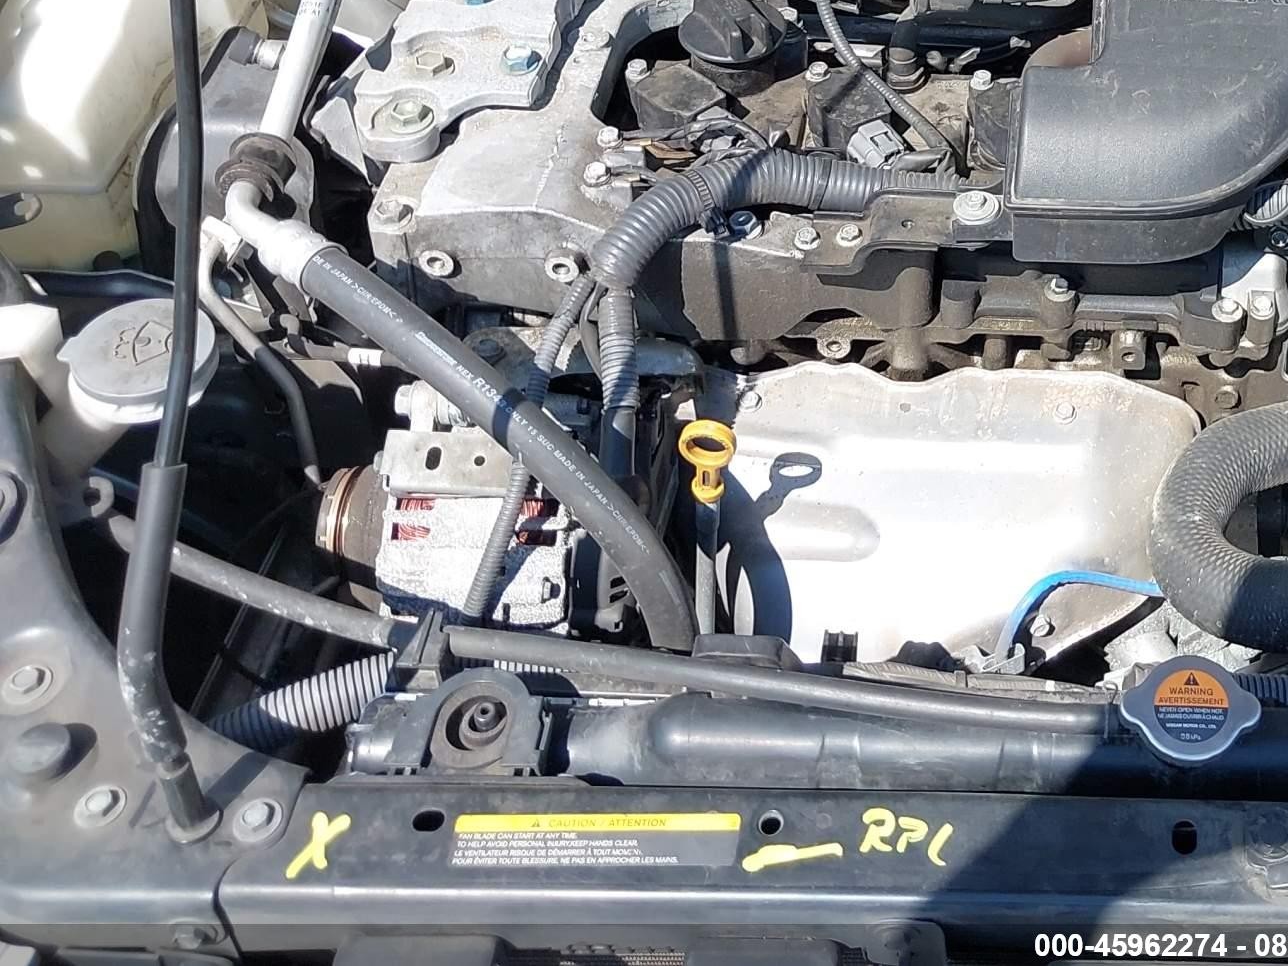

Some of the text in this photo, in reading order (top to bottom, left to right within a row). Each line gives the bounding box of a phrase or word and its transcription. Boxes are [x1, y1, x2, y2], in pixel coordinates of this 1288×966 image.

[330, 268, 353, 285] JAPAN
[505, 407, 528, 425] ONLY
[553, 450, 577, 472] MADE
[576, 471, 585, 480] IN
[584, 480, 608, 504] JAPAN
[1169, 687, 1214, 695] WARNING
[1158, 697, 1225, 705] AVERTISSEMENT
[549, 819, 597, 827] CAUTION
[608, 818, 667, 826] ATTENTION
